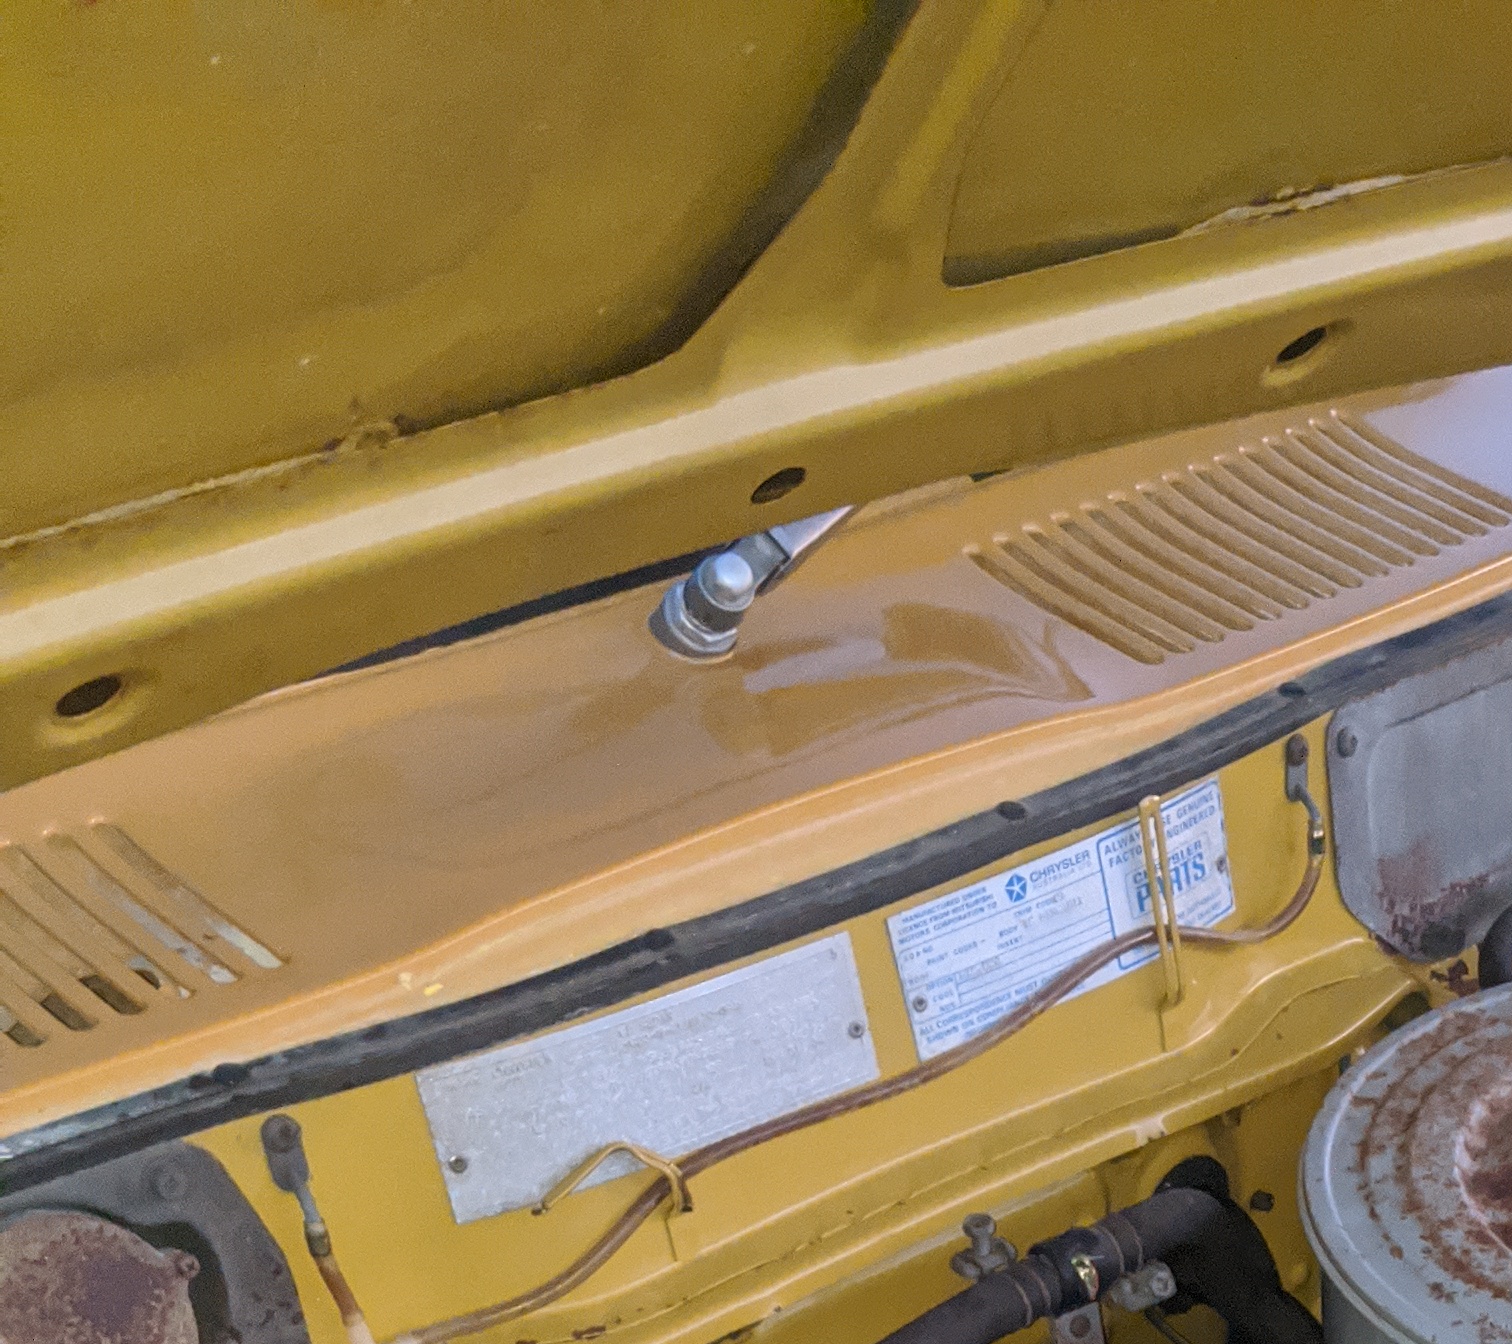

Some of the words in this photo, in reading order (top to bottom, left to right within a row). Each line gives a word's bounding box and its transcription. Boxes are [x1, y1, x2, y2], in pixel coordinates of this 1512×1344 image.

[1104, 830, 1142, 855] ALWAY
[1176, 790, 1215, 819] GENUINE
[1165, 805, 1216, 839] NGINEERED
[1029, 849, 1091, 883] CHRYSLER
